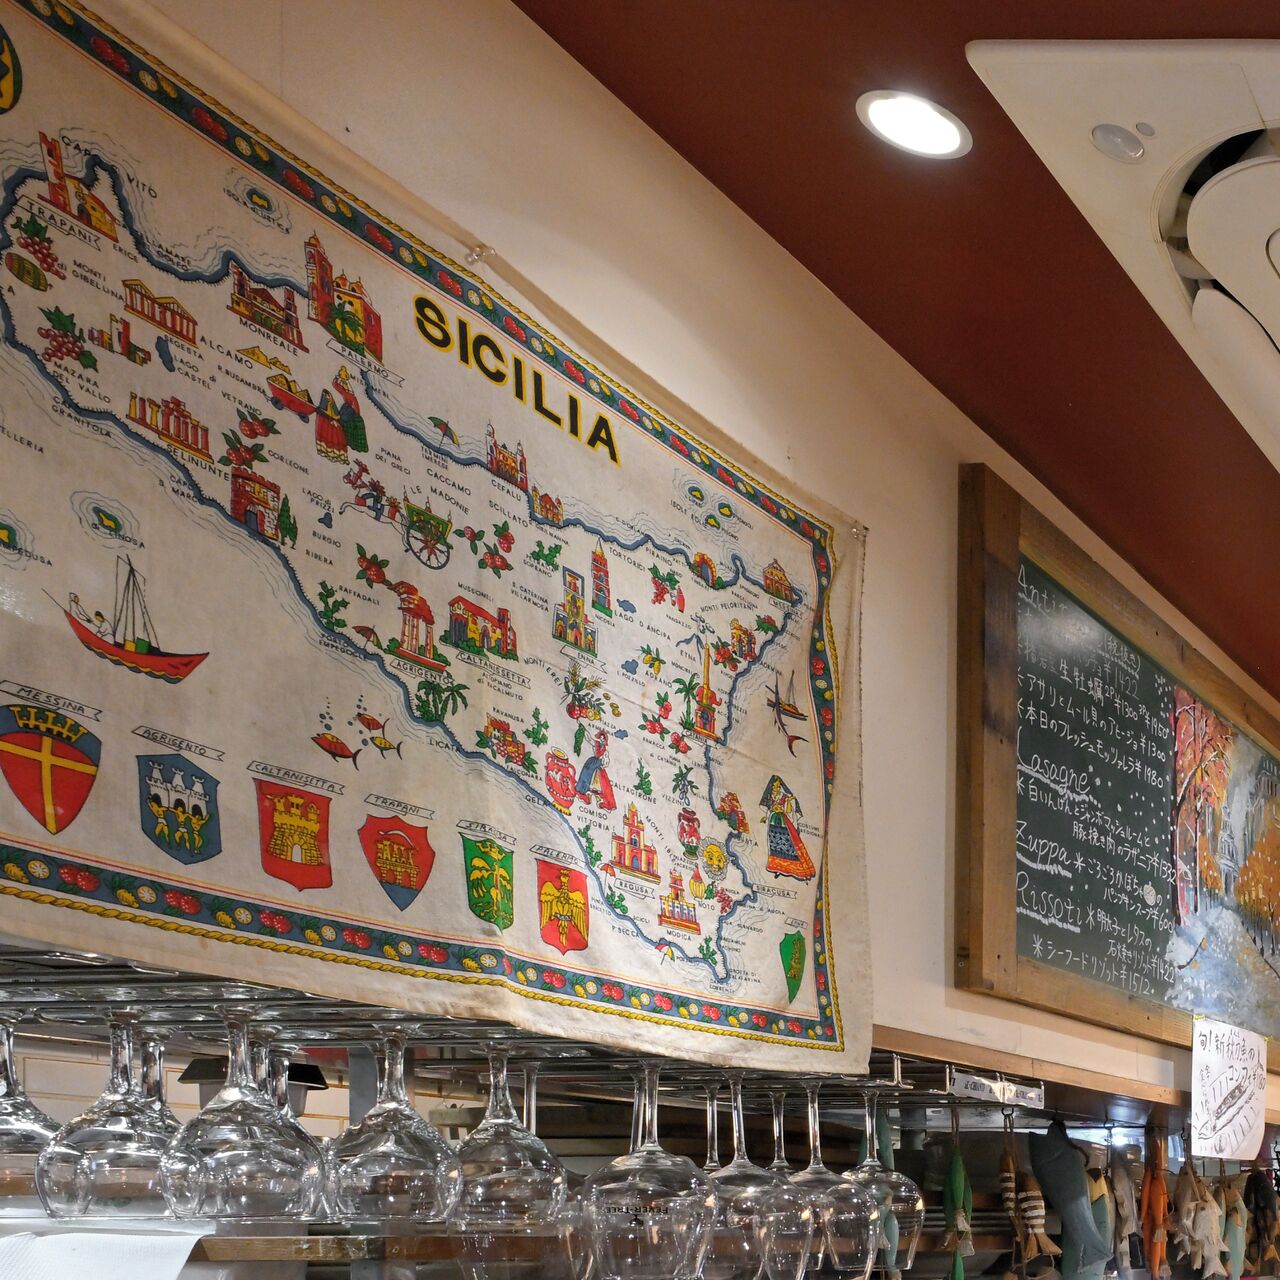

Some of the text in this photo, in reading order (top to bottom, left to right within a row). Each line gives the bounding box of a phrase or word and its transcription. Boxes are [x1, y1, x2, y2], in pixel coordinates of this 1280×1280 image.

[126, 172, 158, 198] VITO
[27, 201, 100, 246] TRAPANI
[73, 259, 107, 281] MONTI
[163, 334, 204, 360] SEGESTA
[239, 316, 299, 357] MONREALE
[174, 355, 200, 373] LAGO
[200, 335, 254, 370] ALCAMO
[340, 344, 389, 378] PALERMO
[53, 361, 98, 388] MAZARA
[53, 370, 111, 404] DEL VALLO
[177, 367, 212, 390] CASTEL
[413, 294, 624, 467] SICILIA
[51, 404, 113, 439] GRANITOLA
[166, 443, 231, 482] SELINUNTE
[267, 449, 310, 475] CORLEONE
[426, 467, 472, 496] CACCAMO
[430, 486, 470, 516] MADONIE
[488, 500, 528, 528] SCILLATO
[305, 549, 333, 566] RIBERA
[609, 547, 646, 572] TORTORICI
[614, 611, 633, 622] LAGO
[460, 652, 526, 685] CALTANISSETTA
[578, 652, 595, 665] ENNA
[680, 650, 697, 662] ETNA
[396, 660, 450, 684] AGRIGENTO
[17, 685, 86, 715] MESSINA
[143, 728, 208, 756] AGRIGENTO
[255, 763, 335, 791] CALTANISETTA
[373, 795, 420, 816] TRAPANI
[579, 806, 608, 820] COMISO
[577, 815, 609, 832] VITTORIA
[619, 881, 650, 895] RAGUSA
[756, 886, 792, 897] SIRACUSA
[666, 929, 692, 942] MODICA
